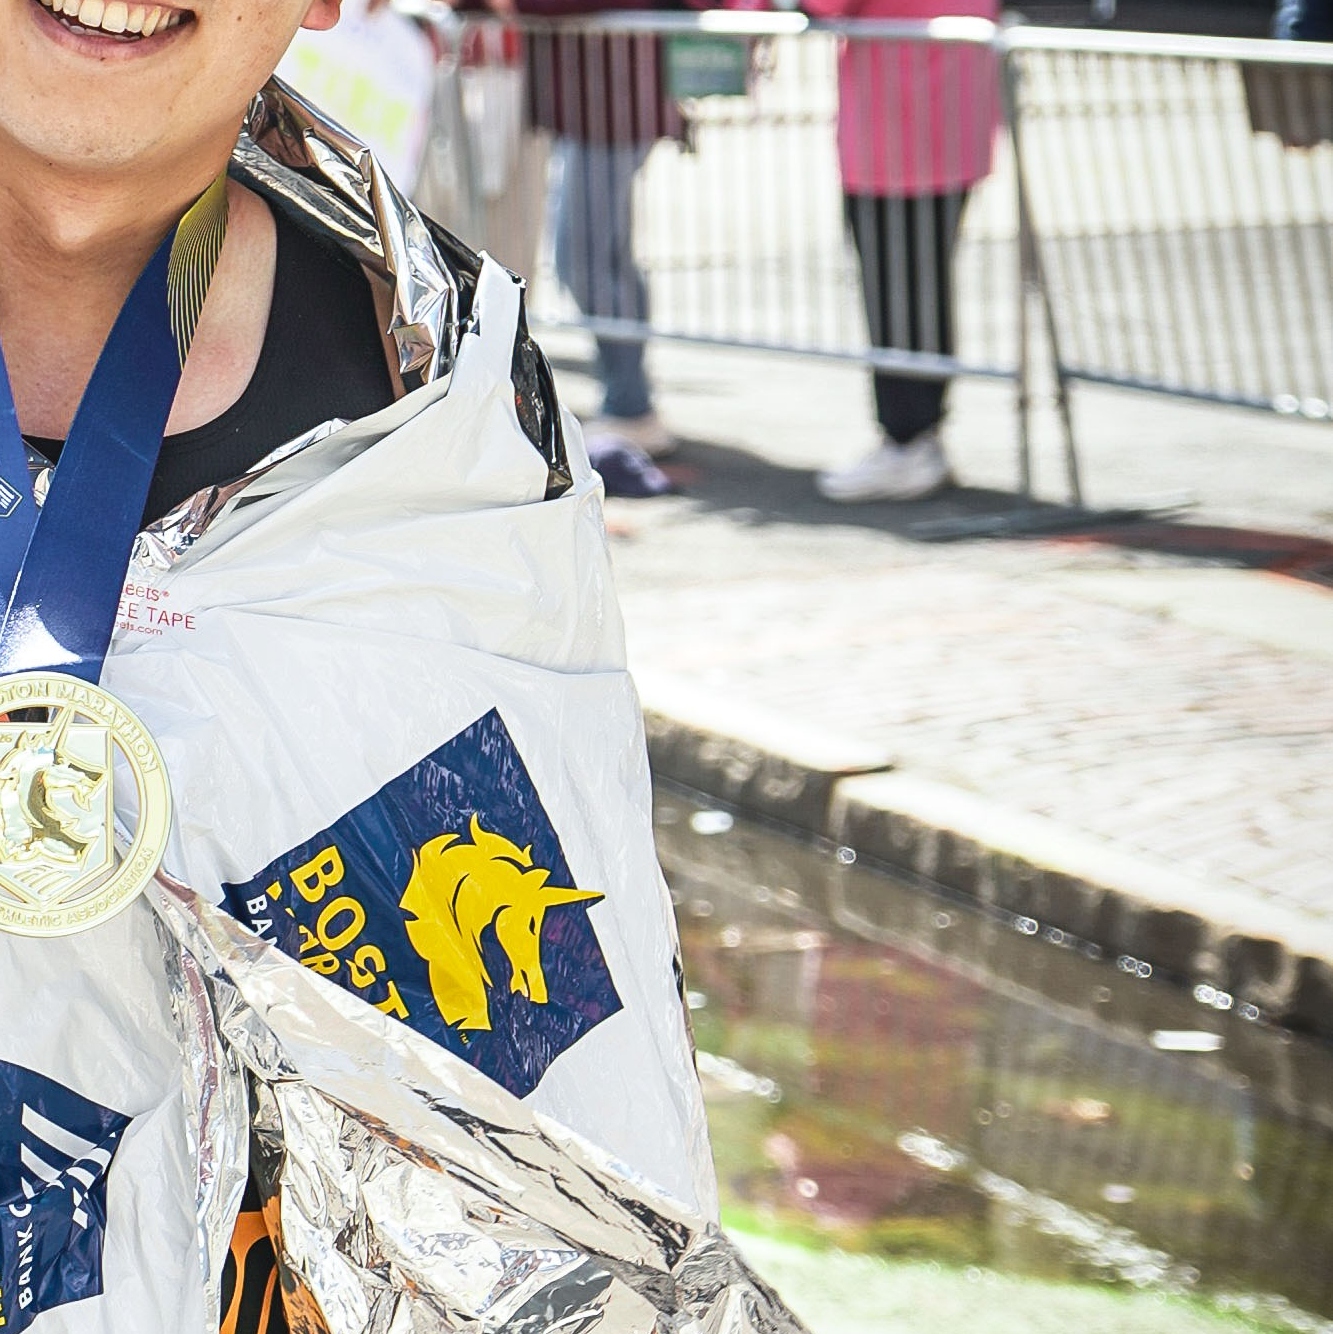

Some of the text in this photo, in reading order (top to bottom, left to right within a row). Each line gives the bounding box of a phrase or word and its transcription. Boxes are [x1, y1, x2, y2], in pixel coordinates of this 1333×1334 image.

[147, 606, 197, 630] TAPE
[56, 683, 158, 773] MARATHON
[67, 848, 155, 924] ASSOCIATION
[289, 845, 410, 1020] BOST
[17, 1222, 34, 1310] BANK
